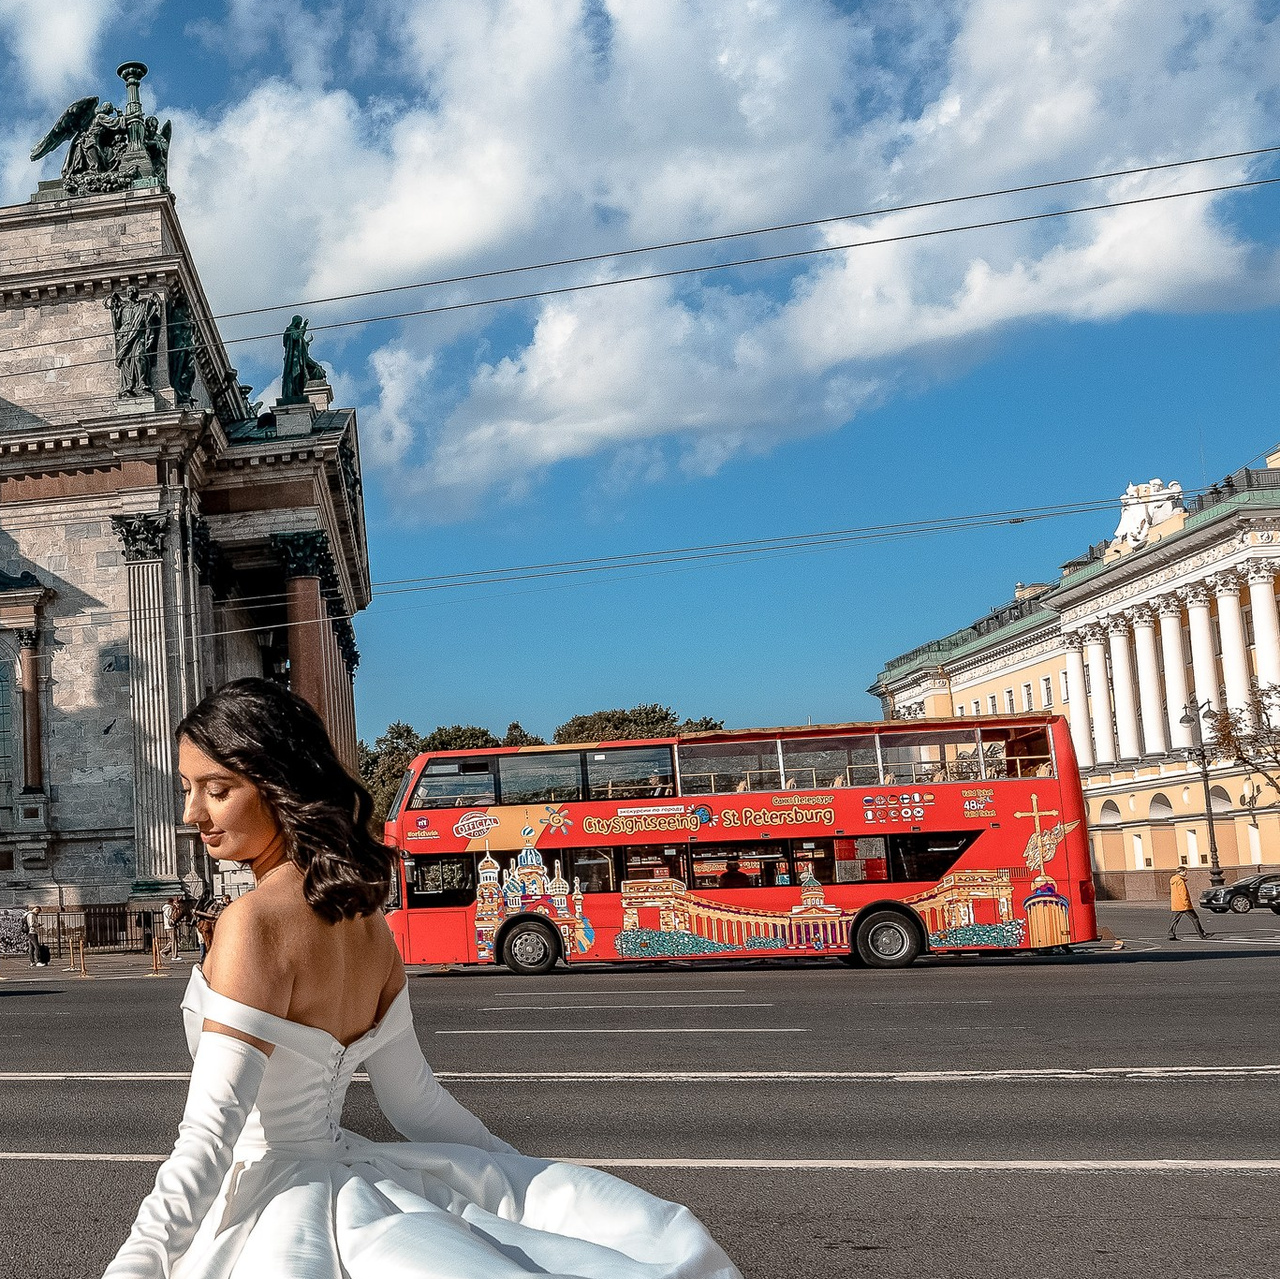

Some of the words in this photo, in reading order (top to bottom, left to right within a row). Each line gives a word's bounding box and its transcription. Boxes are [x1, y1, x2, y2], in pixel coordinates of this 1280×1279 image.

[721, 809, 740, 827] St
[742, 806, 834, 826] Petersburg
[458, 818, 497, 834] OFFICIAL
